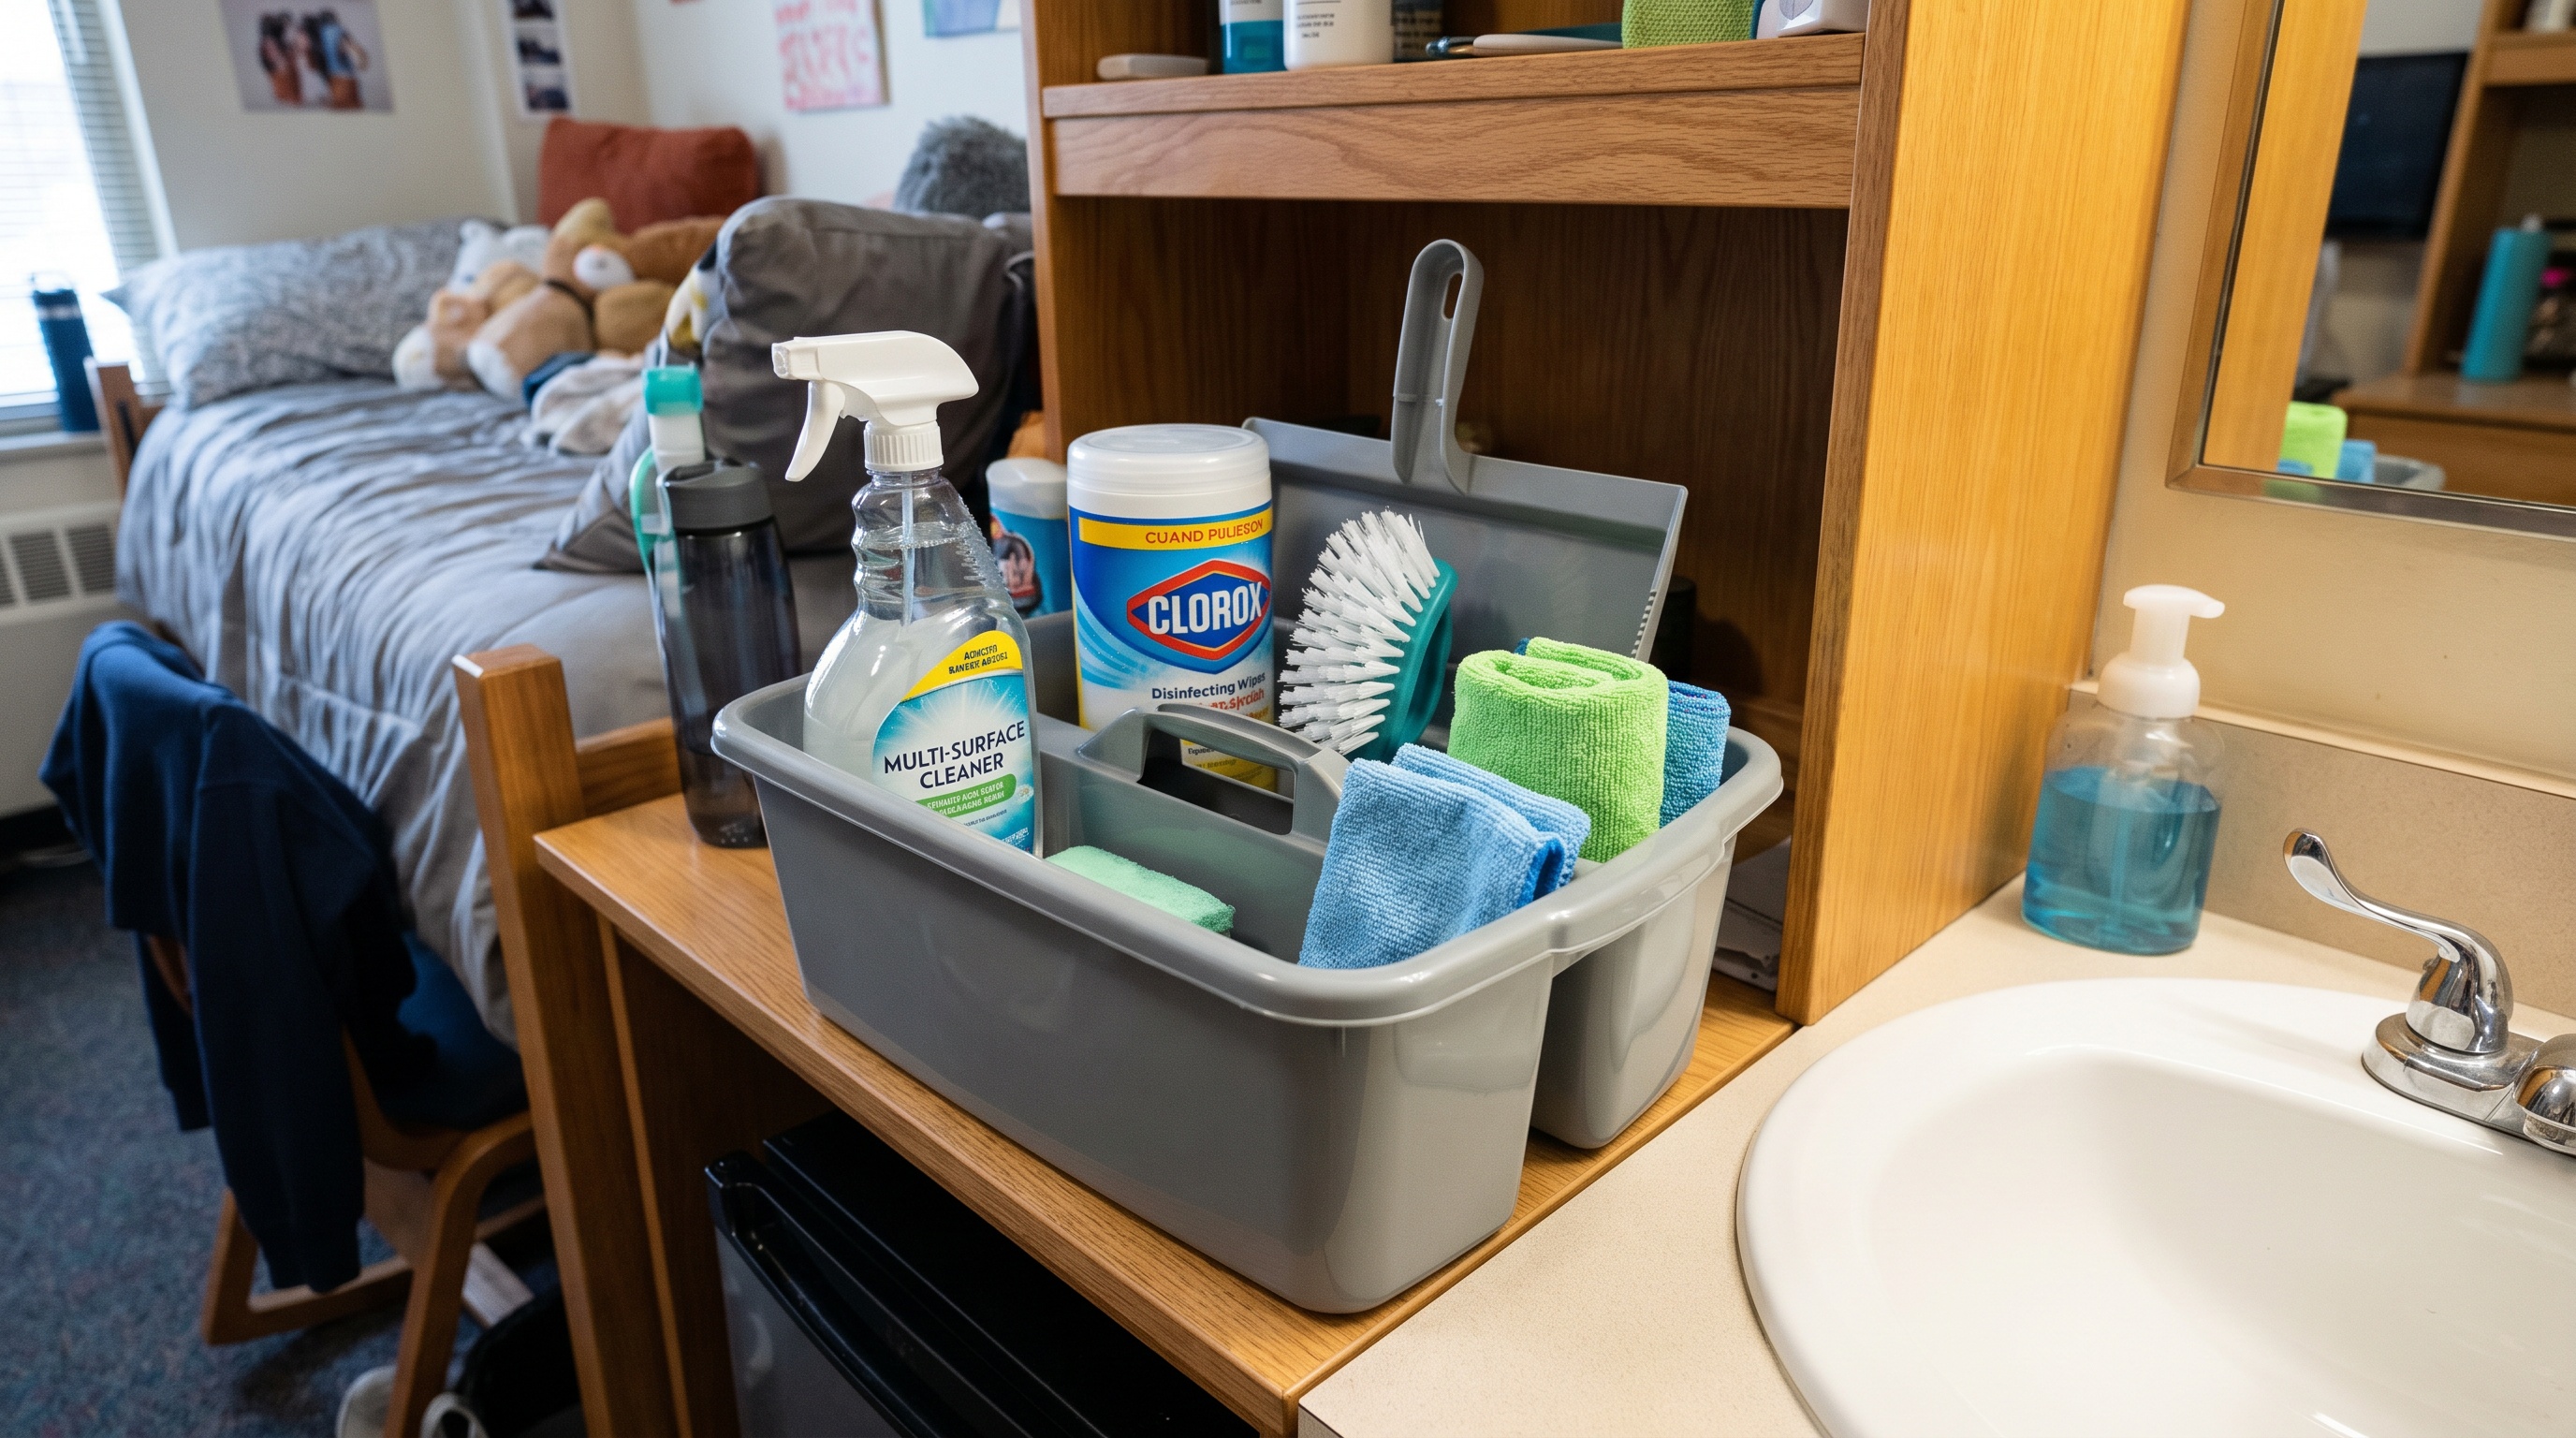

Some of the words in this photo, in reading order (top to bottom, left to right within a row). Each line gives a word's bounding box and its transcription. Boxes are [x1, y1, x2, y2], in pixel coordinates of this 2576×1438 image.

[1145, 530, 1205, 544] CUAND
[1148, 580, 1263, 636] CLOROX
[1152, 683, 1236, 699] Disinfecting
[1237, 672, 1266, 691] Wipes
[885, 720, 1025, 774] MULTI-SURFACE
[919, 752, 1004, 789] CLEANER
